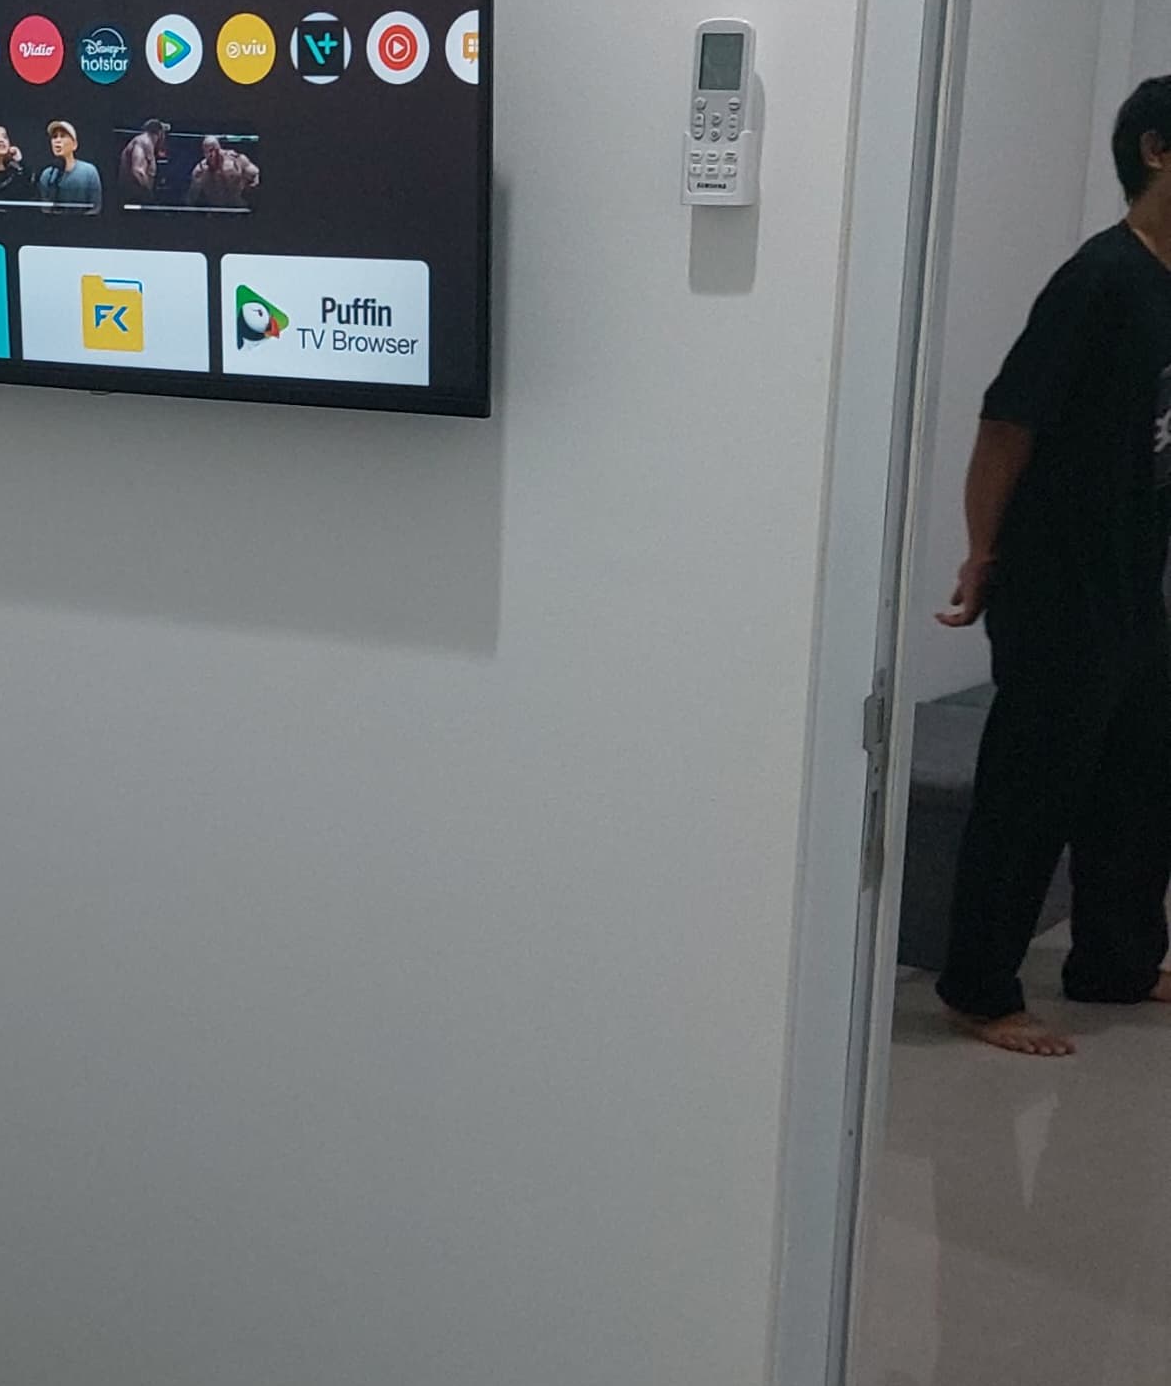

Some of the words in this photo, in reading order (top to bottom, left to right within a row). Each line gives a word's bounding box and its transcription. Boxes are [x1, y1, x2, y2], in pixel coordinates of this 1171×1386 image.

[19, 41, 55, 58] Vidio
[81, 55, 128, 72] hotstar
[321, 296, 392, 328] Puffin
[297, 328, 325, 351] TV
[332, 328, 419, 355] Browser
